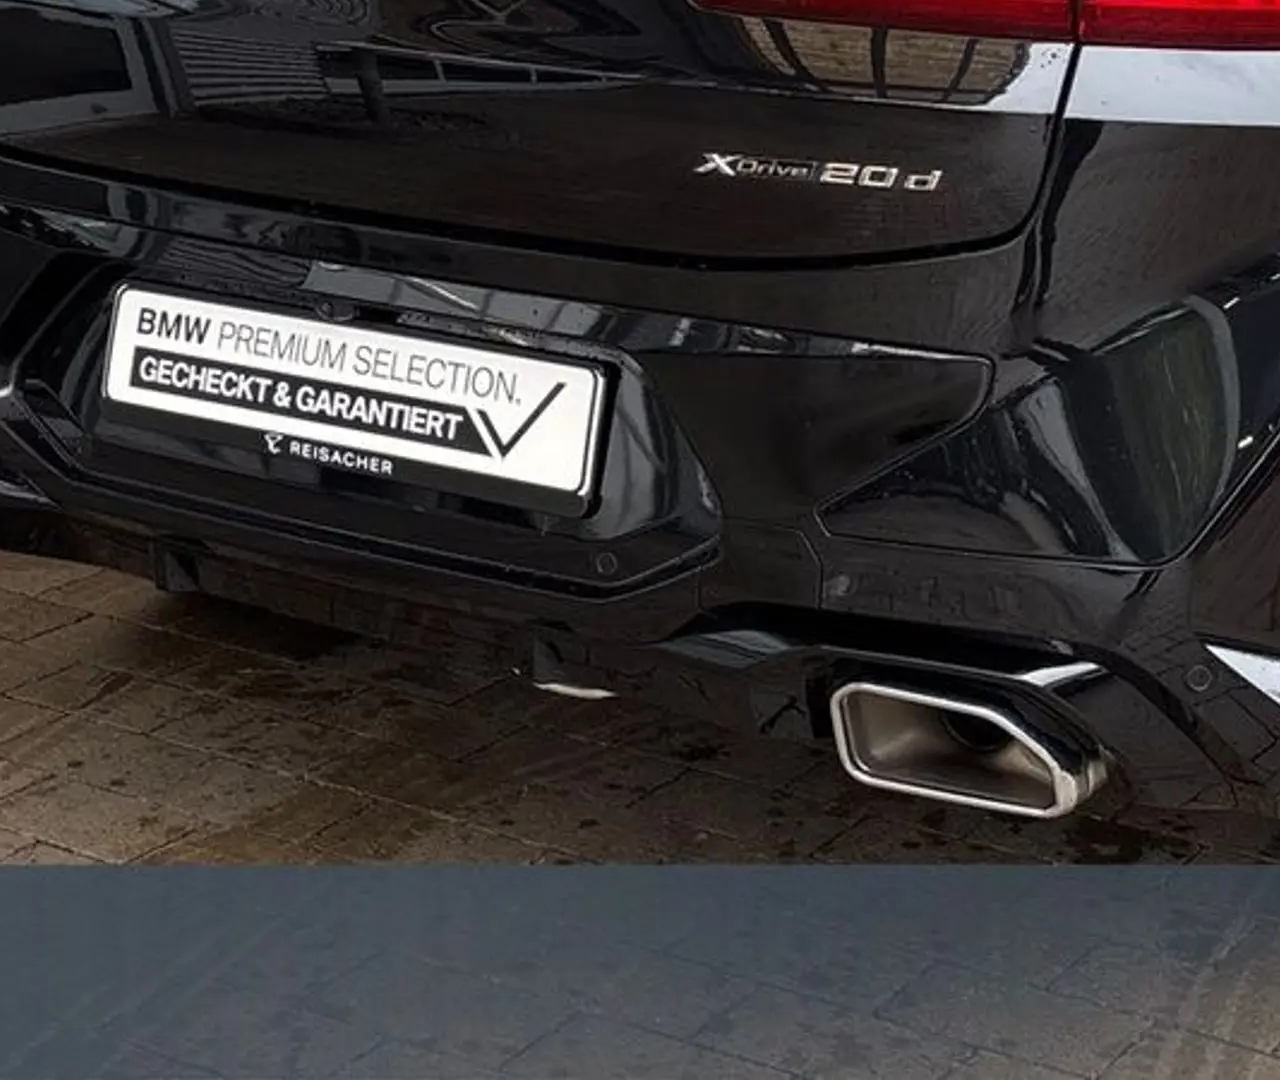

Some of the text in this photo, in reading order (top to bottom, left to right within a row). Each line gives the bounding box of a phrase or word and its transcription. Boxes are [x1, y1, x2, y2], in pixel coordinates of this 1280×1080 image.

[136, 306, 522, 406] BMW PREMIUM SELECTION.
[139, 355, 464, 441] GECHECKT & GARANTIERT
[289, 440, 394, 476] REISACHER
